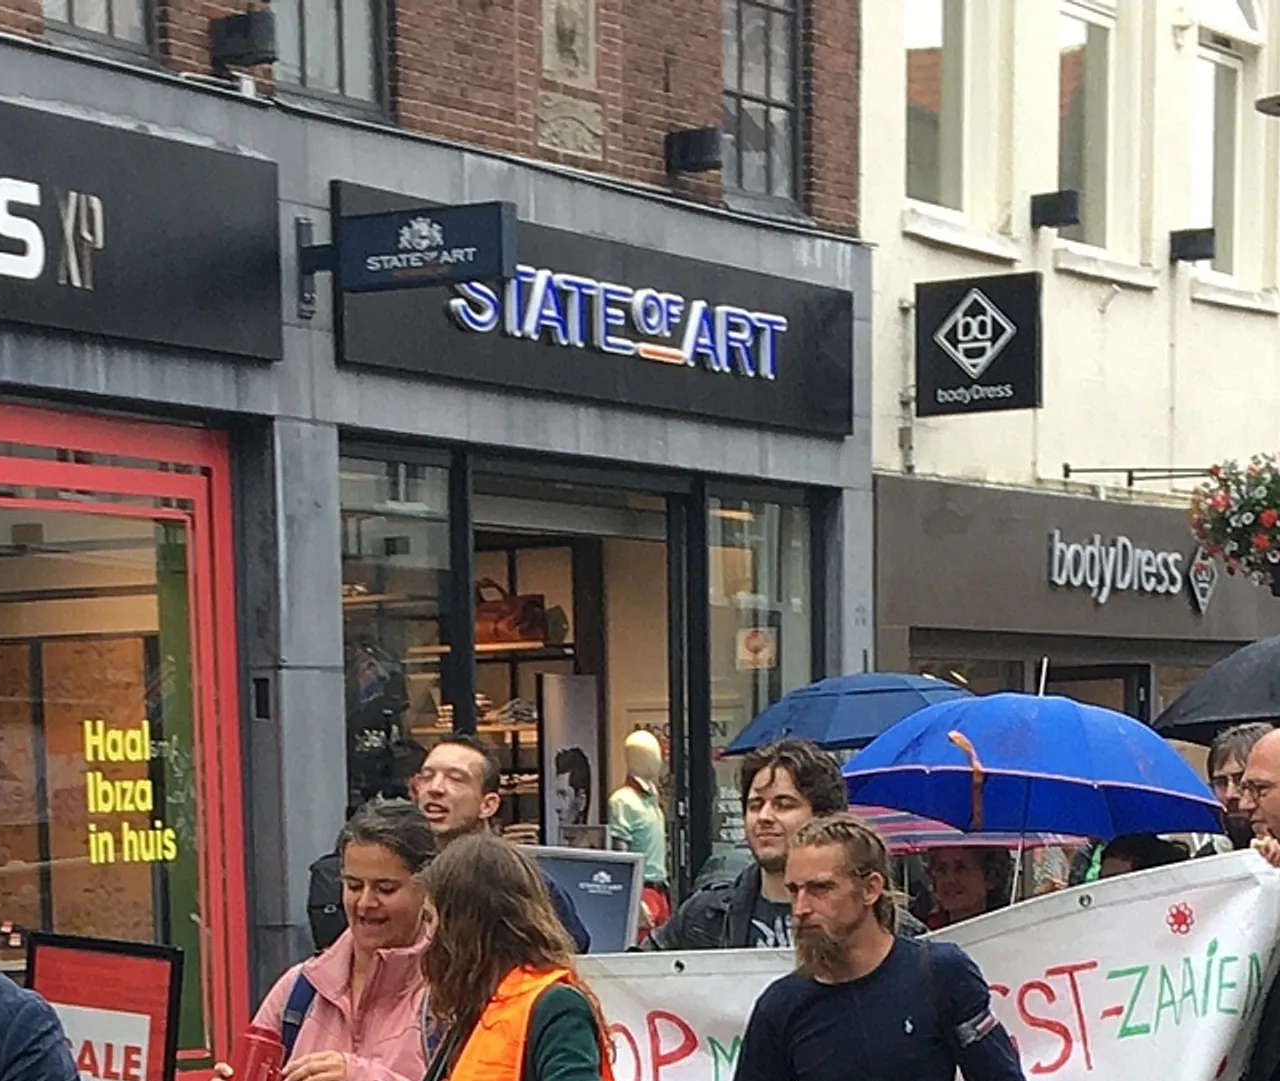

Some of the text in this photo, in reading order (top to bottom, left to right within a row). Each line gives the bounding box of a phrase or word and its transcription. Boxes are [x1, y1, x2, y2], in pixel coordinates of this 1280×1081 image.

[366, 252, 423, 271] STATE
[439, 247, 477, 264] ART
[632, 287, 685, 337] OF
[682, 299, 788, 380] ART
[1050, 528, 1183, 604] bodyDress
[83, 720, 151, 762] Haal
[88, 819, 177, 864] in huis
